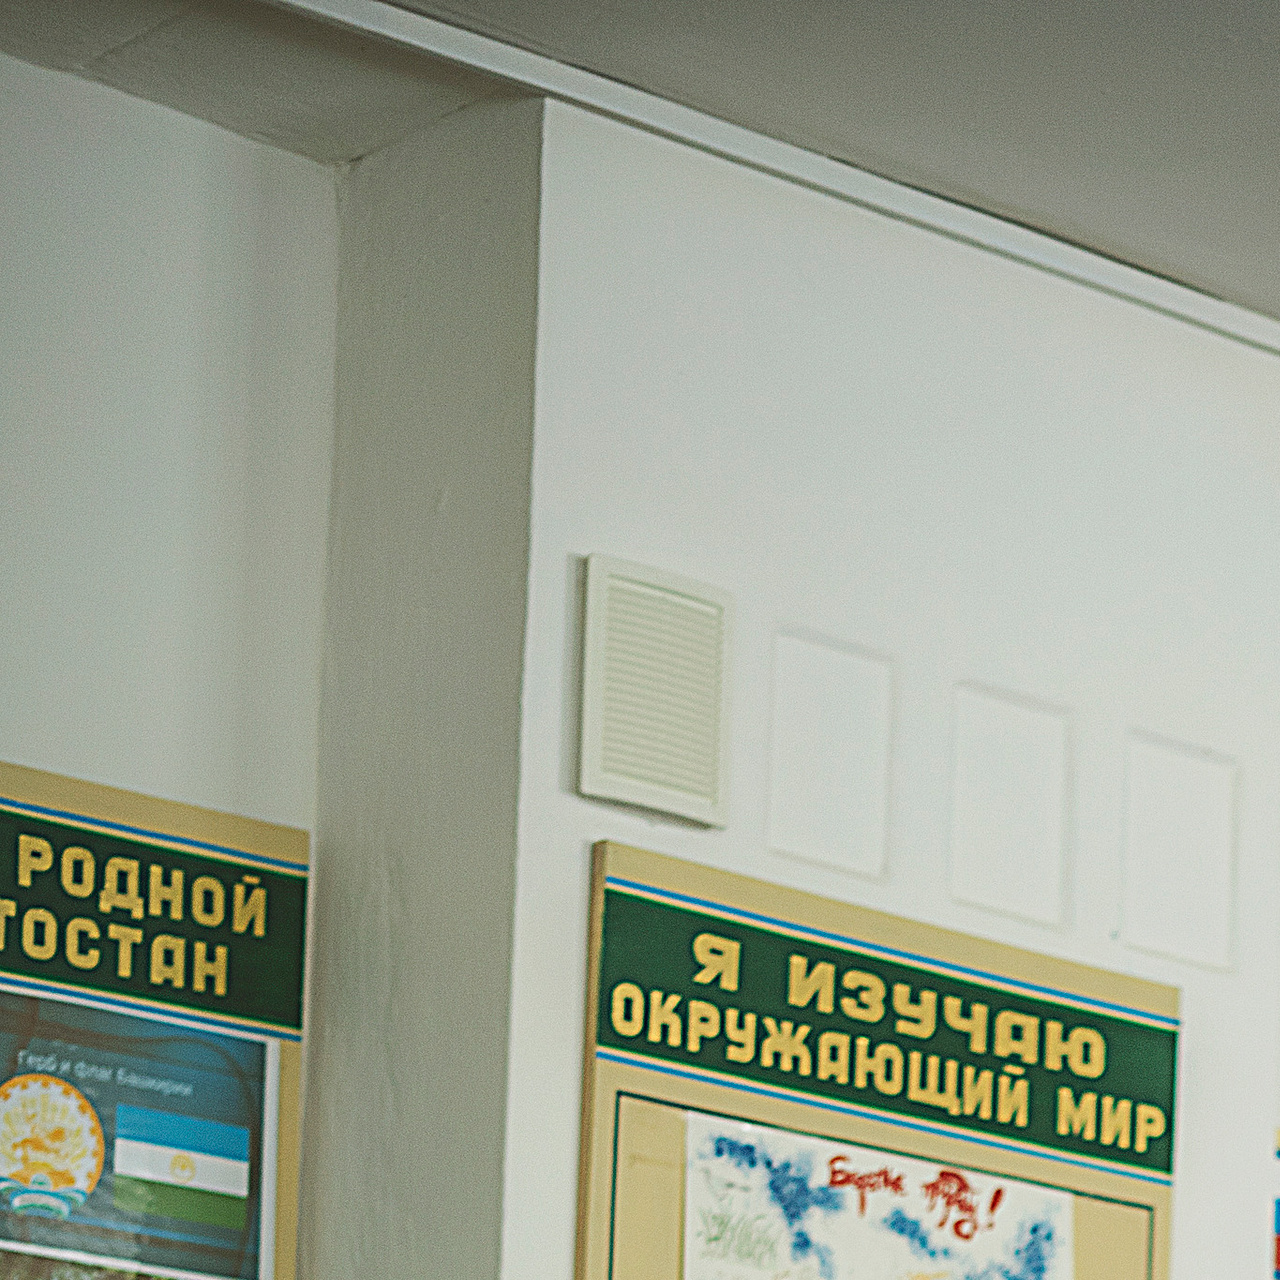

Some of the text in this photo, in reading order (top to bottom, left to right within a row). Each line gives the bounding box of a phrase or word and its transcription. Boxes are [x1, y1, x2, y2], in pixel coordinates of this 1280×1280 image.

[18, 833, 267, 937] РОДНОЙ
[610, 982, 1167, 1154] ОКРУЖАЮЩИЙ МИР
[692, 933, 1106, 1079] Я ИЗУЧАЮ
